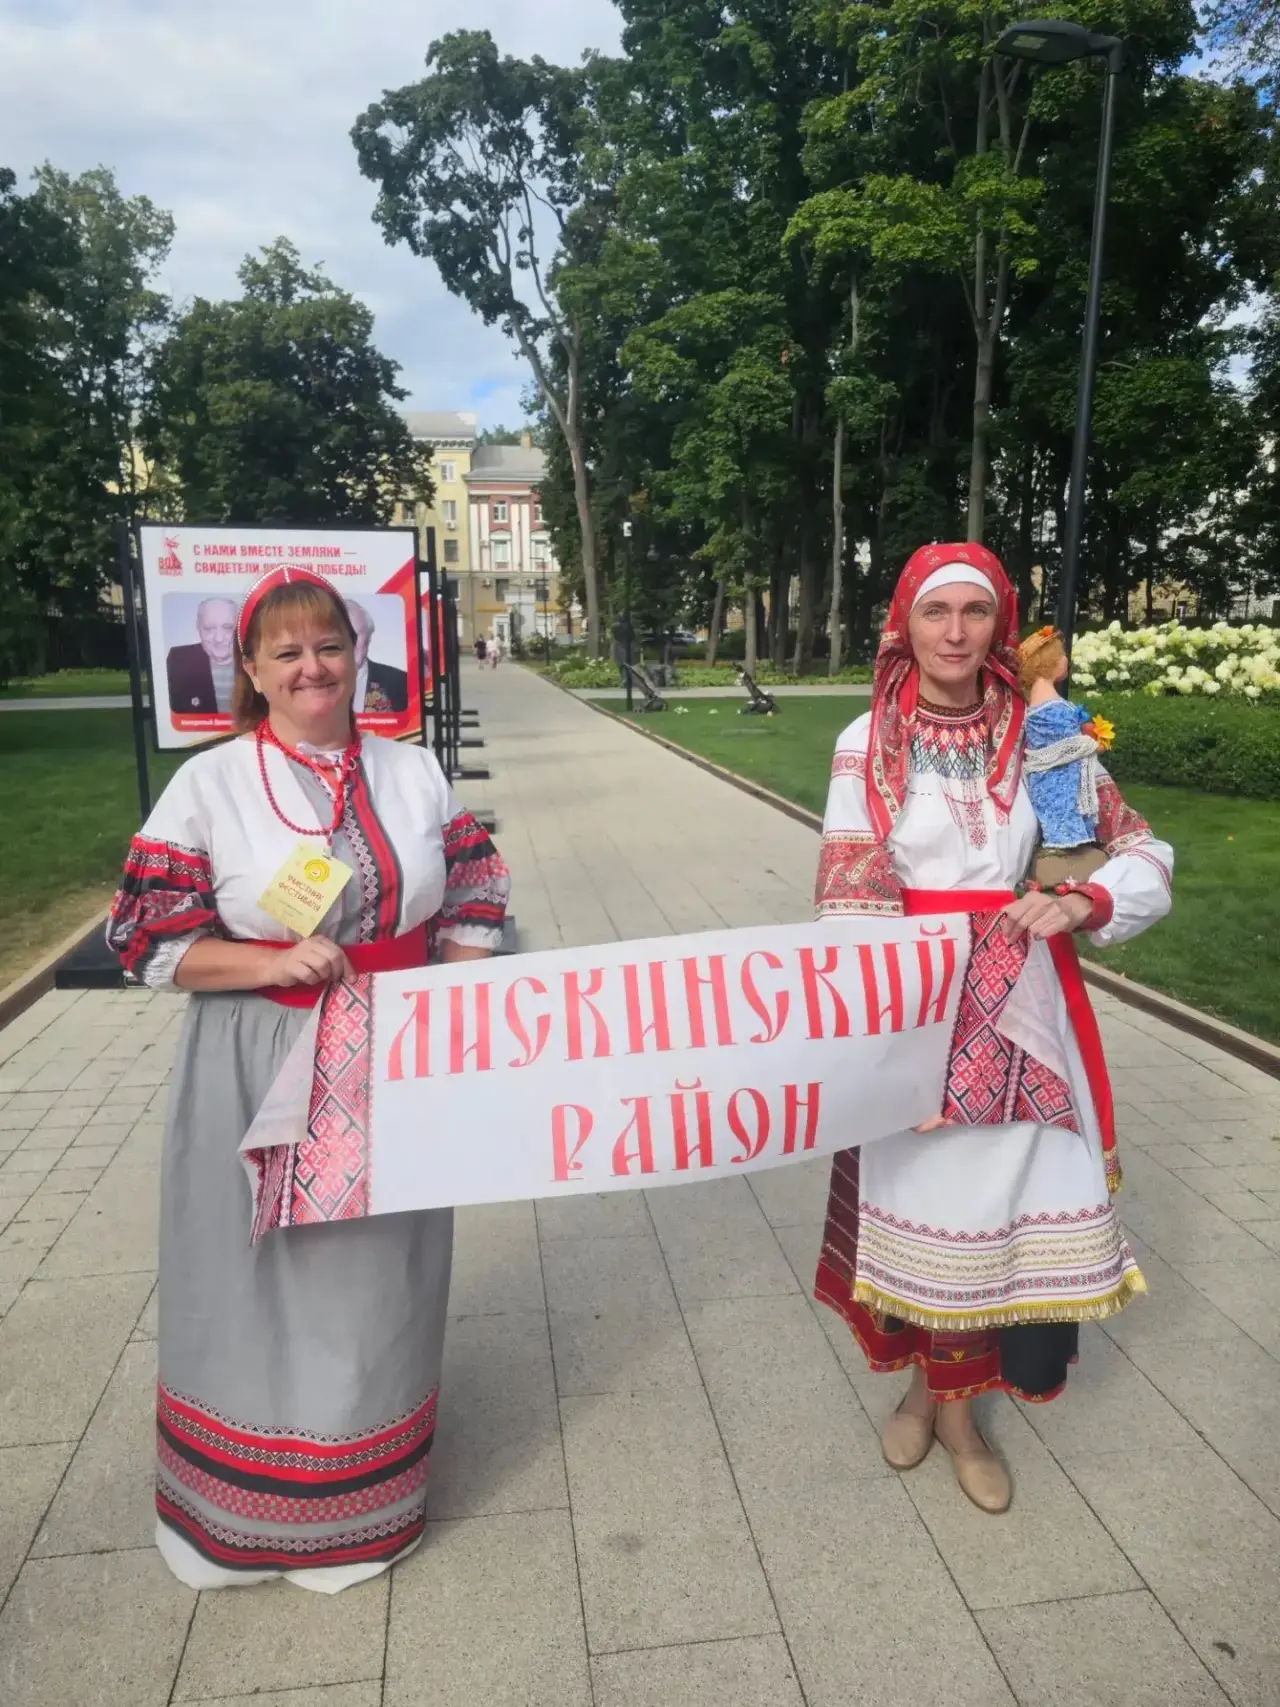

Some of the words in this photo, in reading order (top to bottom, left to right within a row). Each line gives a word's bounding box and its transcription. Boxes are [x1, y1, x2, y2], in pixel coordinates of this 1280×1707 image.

[193, 544, 200, 556] С
[204, 544, 237, 556] НАМИ
[240, 545, 285, 557] ВМЕСТЕ
[288, 545, 341, 558] ЗЕМЛЯКИ
[194, 561, 259, 575] СВИДЕТЕЛИ
[317, 563, 366, 576] ПОБЕДЫ!
[278, 881, 322, 912] ФЕСТИВАЛЯ
[287, 874, 325, 902] УЧАСТНИК
[384, 921, 959, 1082] ЛИСКИНСКИЙ
[550, 1077, 823, 1182] РАЙОН
